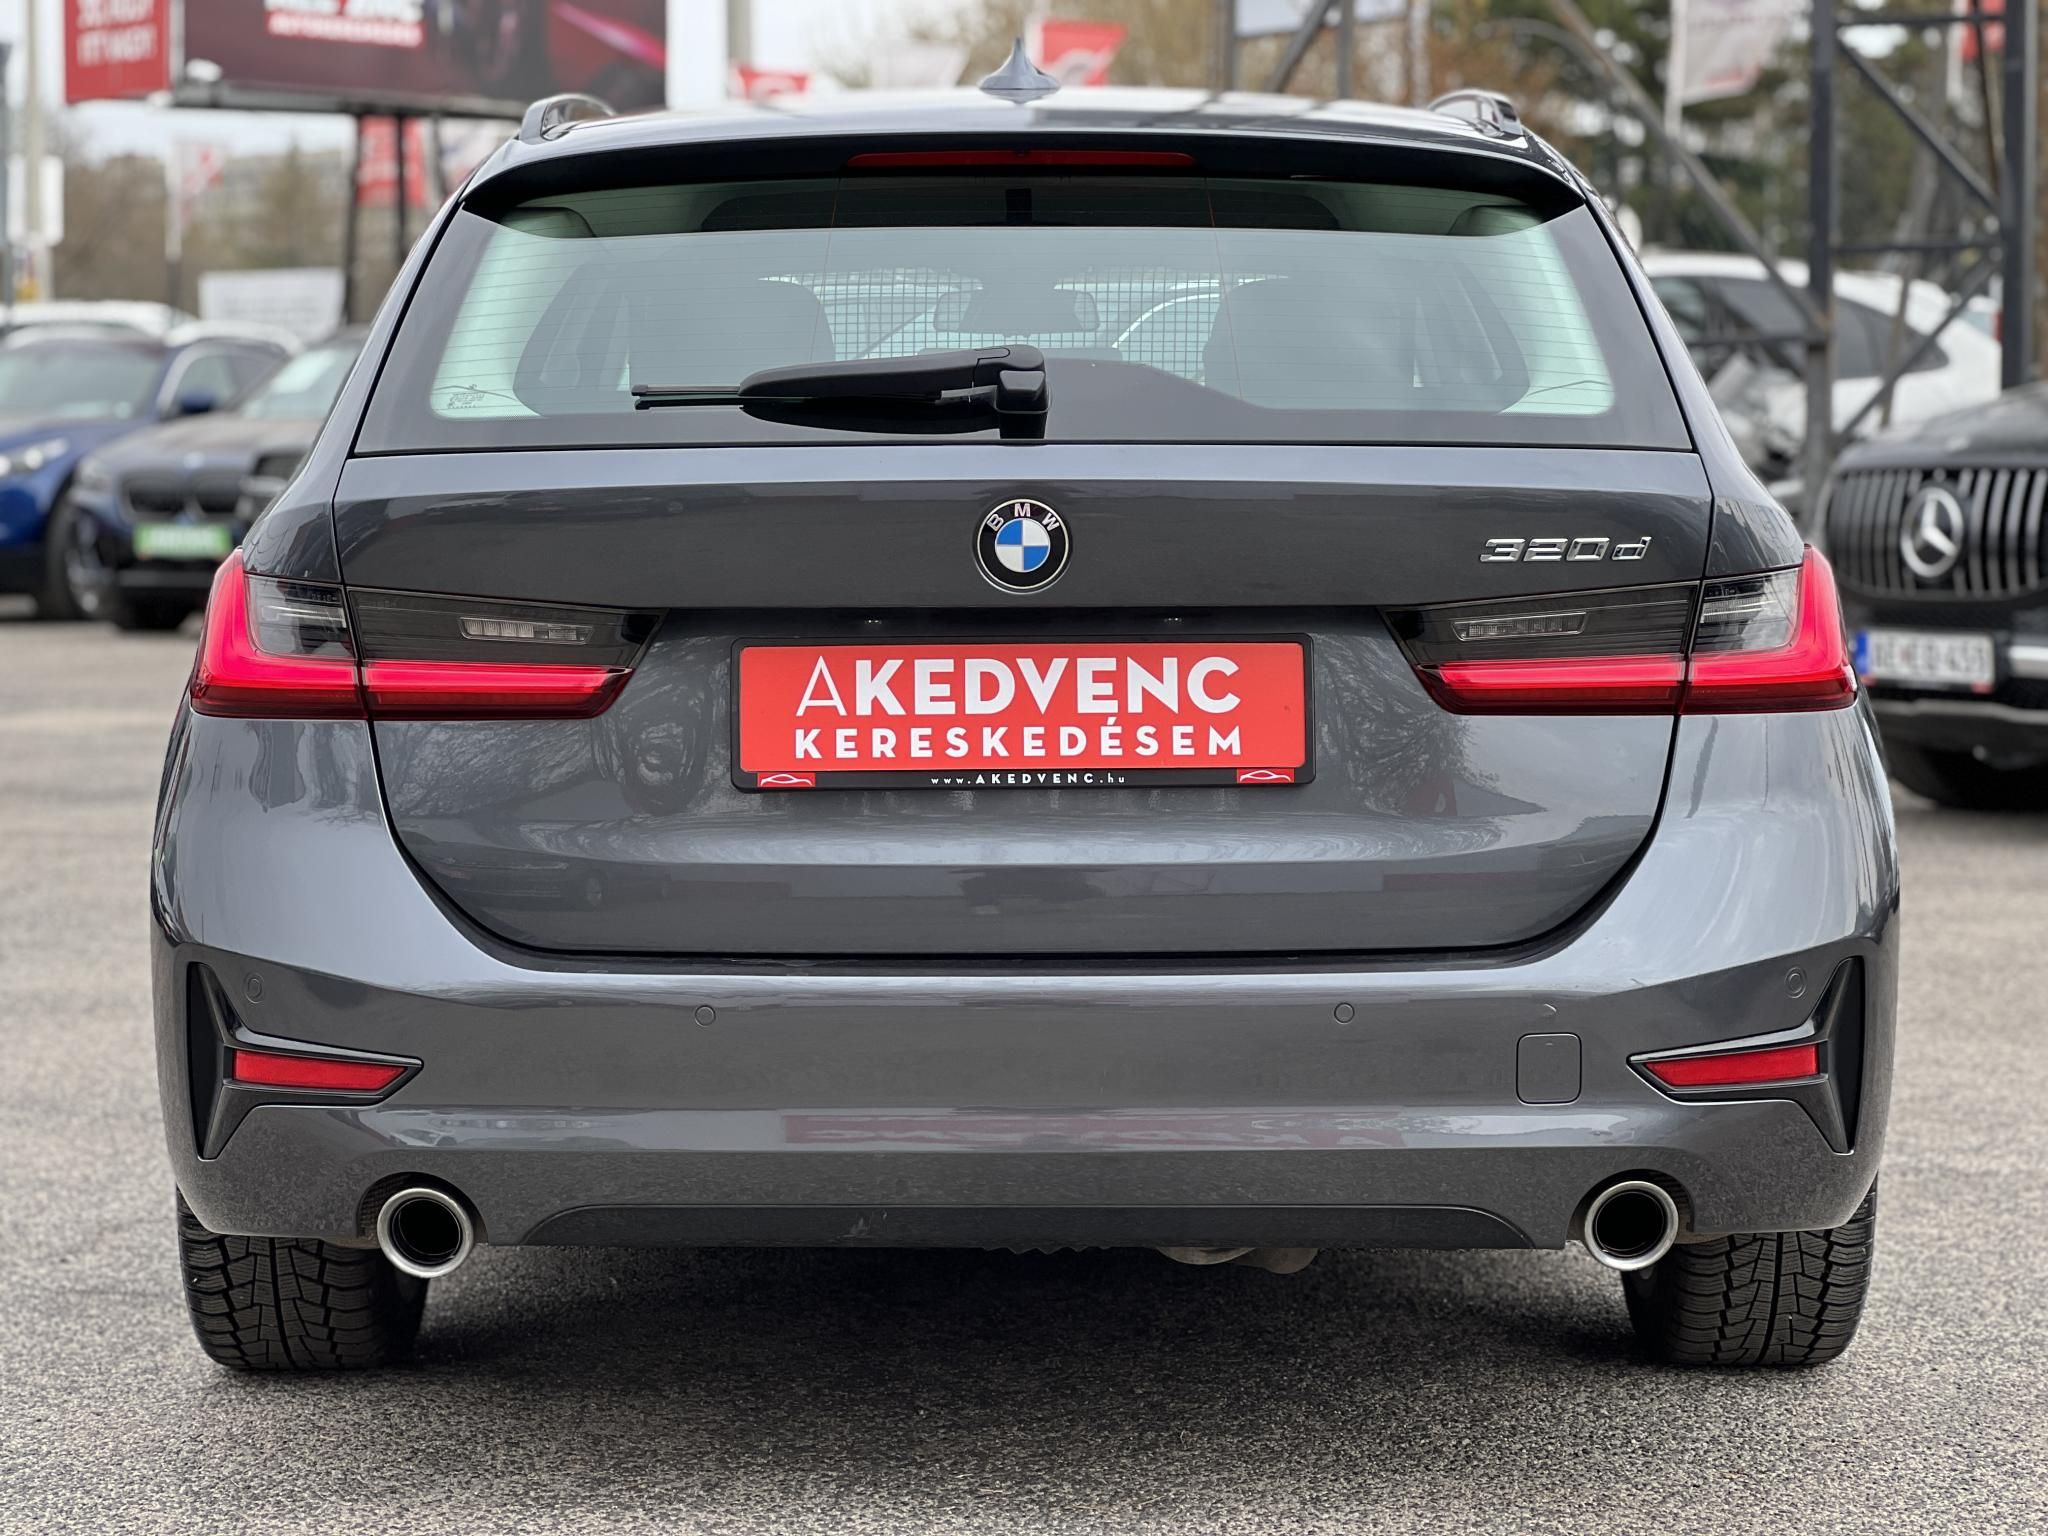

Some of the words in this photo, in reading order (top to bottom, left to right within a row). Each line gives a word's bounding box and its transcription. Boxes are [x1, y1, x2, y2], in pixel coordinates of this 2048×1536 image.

[986, 502, 1060, 532] BMW
[1480, 536, 1652, 562] 320d
[795, 655, 1241, 716] AKEDVENC
[795, 717, 1242, 759] KERESKEDÉSEM
[931, 772, 1125, 785] www.AKEDVENC.hu
